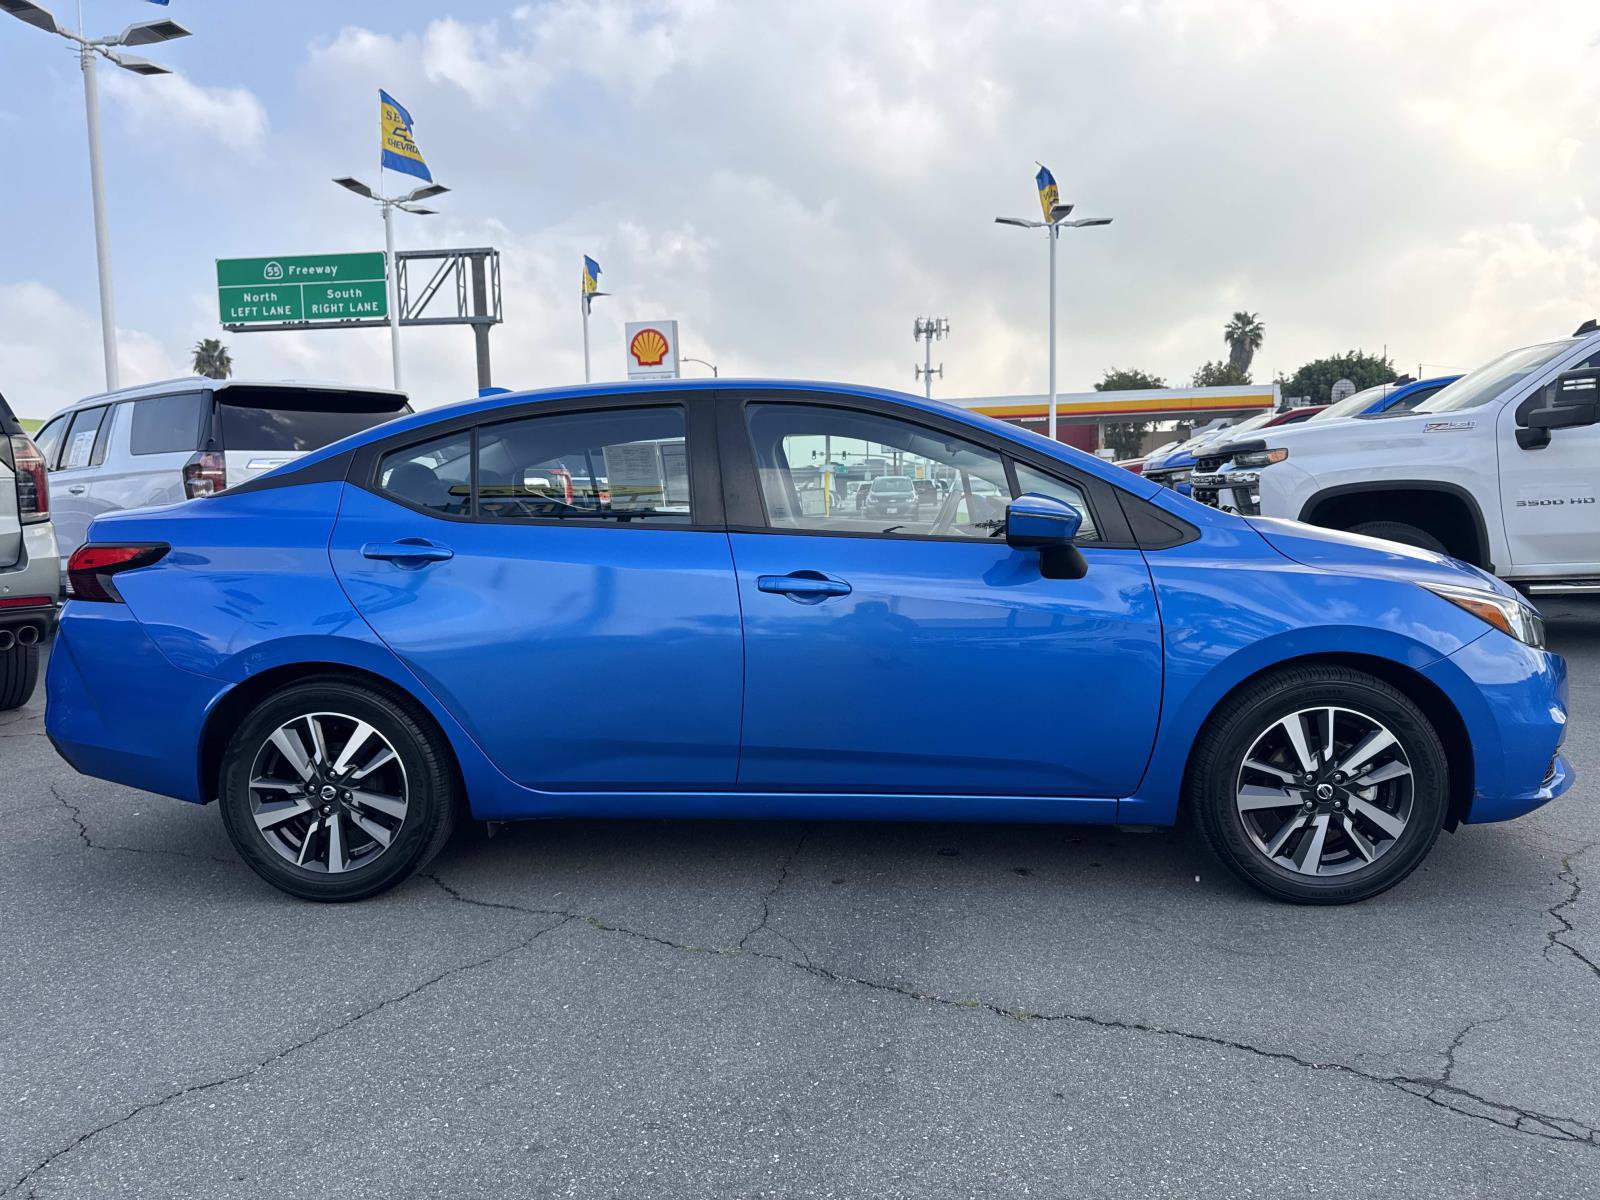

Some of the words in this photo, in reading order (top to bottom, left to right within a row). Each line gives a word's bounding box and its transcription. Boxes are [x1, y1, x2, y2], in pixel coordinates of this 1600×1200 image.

[386, 109, 404, 124] SE
[267, 266, 280, 277] 55
[288, 265, 338, 277] Freeway
[243, 292, 278, 302] North
[327, 288, 362, 299] South
[231, 306, 258, 317] LEFT
[262, 305, 292, 316] LANE
[311, 303, 345, 314] RIGHT
[349, 301, 379, 312] LANE
[1515, 499, 1565, 507] 3500
